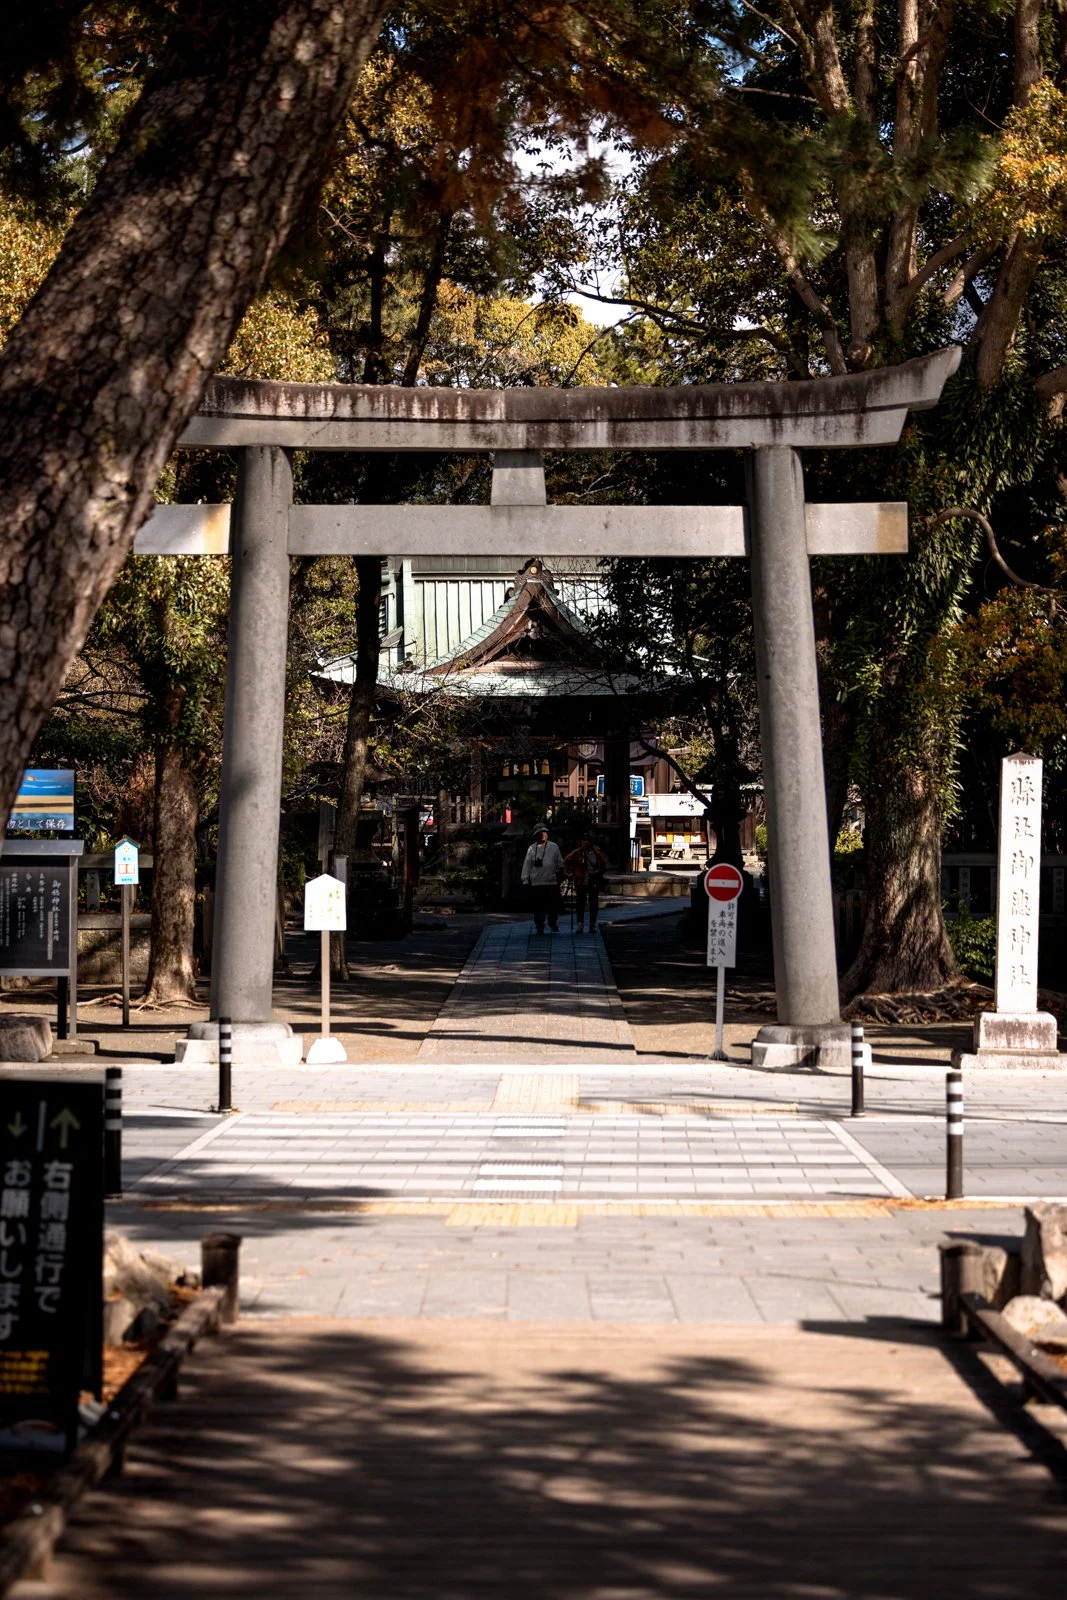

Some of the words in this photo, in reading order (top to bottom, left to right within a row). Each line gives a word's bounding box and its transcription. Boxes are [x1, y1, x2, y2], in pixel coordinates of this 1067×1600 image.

[709, 919, 718, 964] を禁じます
[717, 910, 726, 956] 車両の進入
[727, 902, 735, 938] 許可無く
[34, 1159, 73, 1313] 右側通行で
